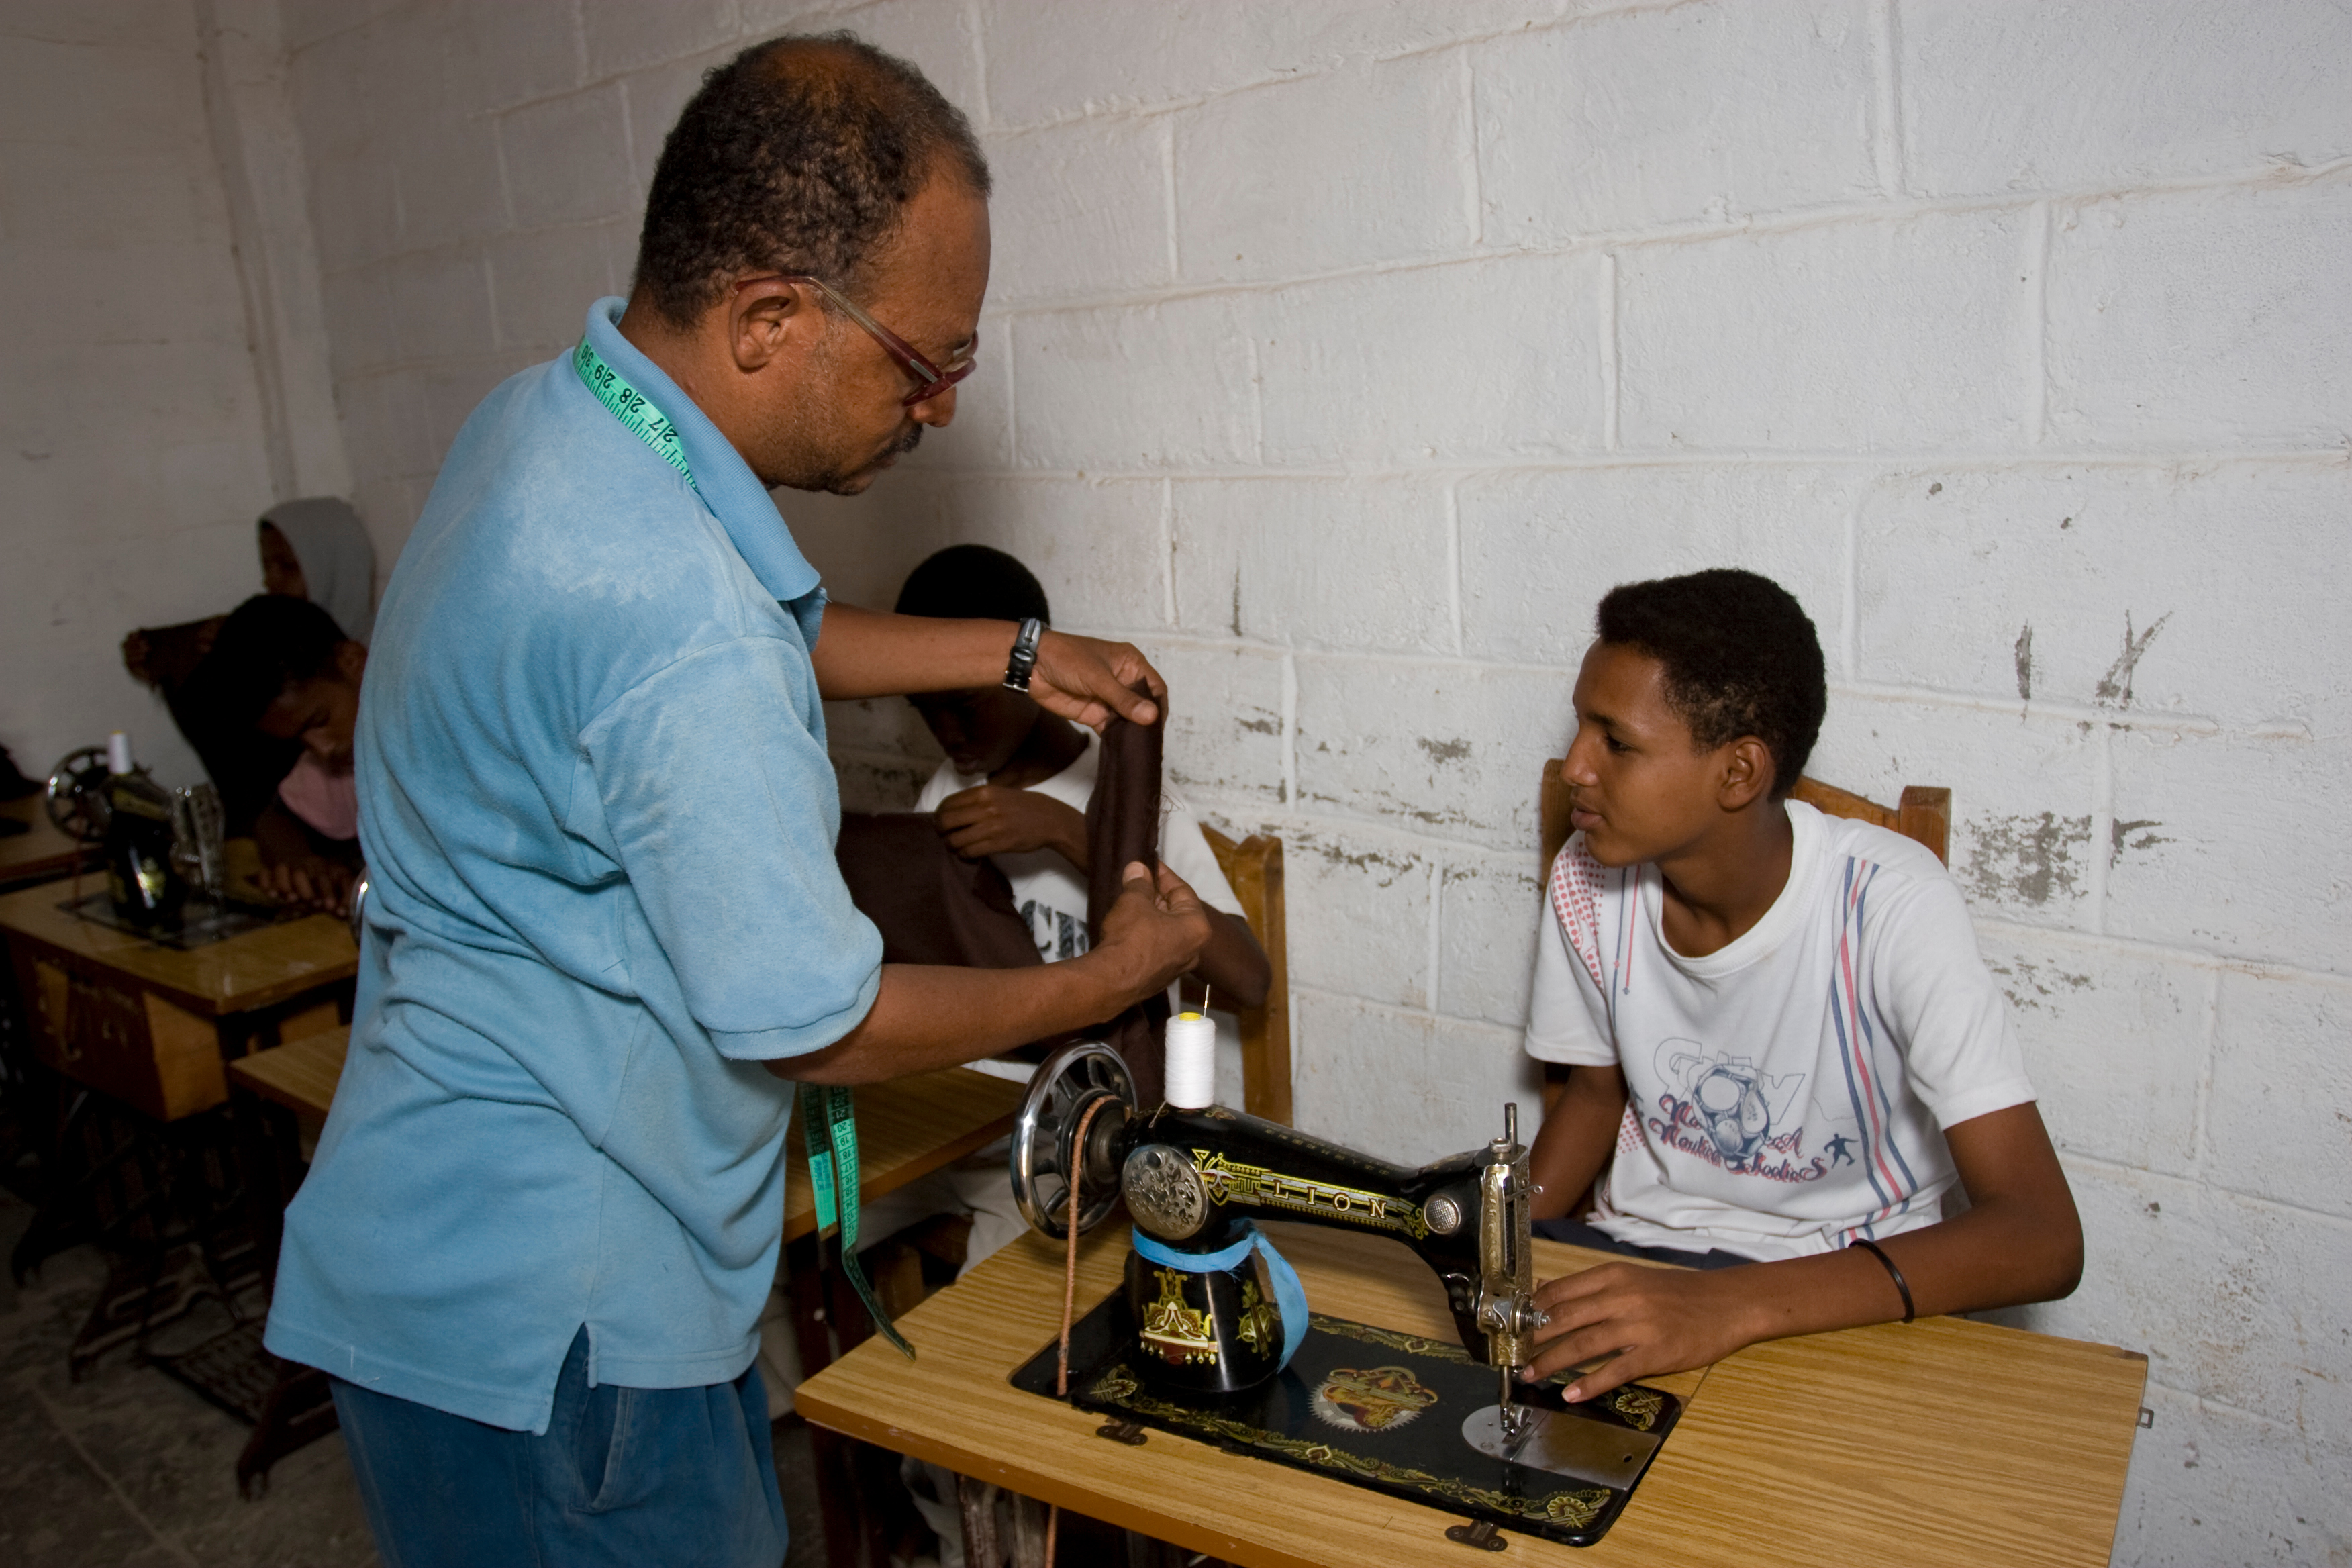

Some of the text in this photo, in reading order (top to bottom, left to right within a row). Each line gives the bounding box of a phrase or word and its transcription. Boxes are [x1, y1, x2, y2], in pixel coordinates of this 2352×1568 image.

[594, 364, 616, 389] 29
[619, 387, 646, 413] 28
[837, 1122, 847, 1133] 20
[1272, 1178, 1387, 1220] LION
